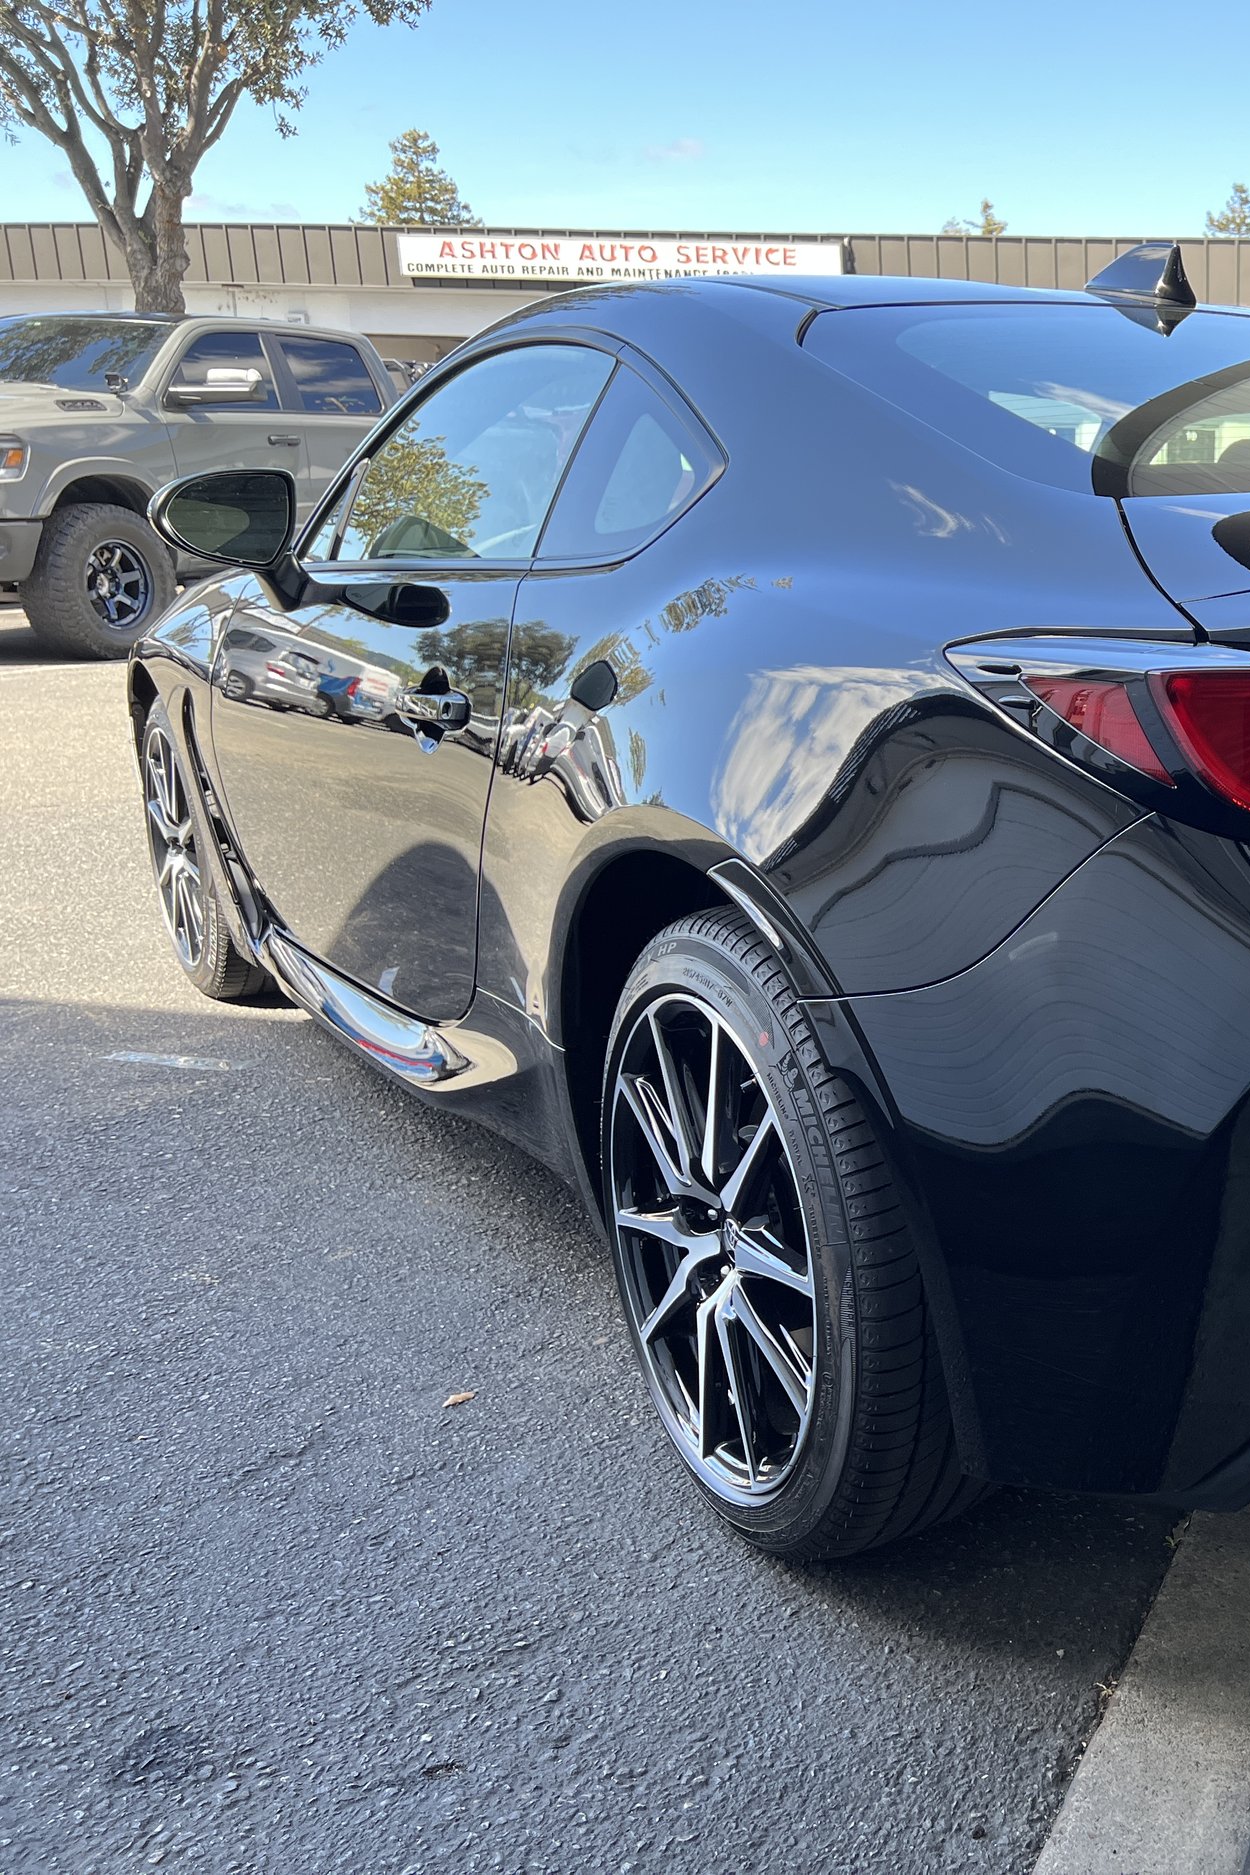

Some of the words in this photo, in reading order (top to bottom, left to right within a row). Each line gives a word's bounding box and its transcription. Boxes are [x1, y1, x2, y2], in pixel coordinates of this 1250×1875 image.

[439, 240, 561, 261] ASHTON
[579, 243, 658, 263] AUTO
[677, 245, 797, 266] SERVICE
[407, 262, 474, 274] COMPLETE
[481, 265, 515, 275] AUTO
[522, 265, 569, 276] REPAIR
[577, 266, 603, 277] AND
[657, 942, 677, 956] HP
[793, 1089, 848, 1243] MICHELIN
